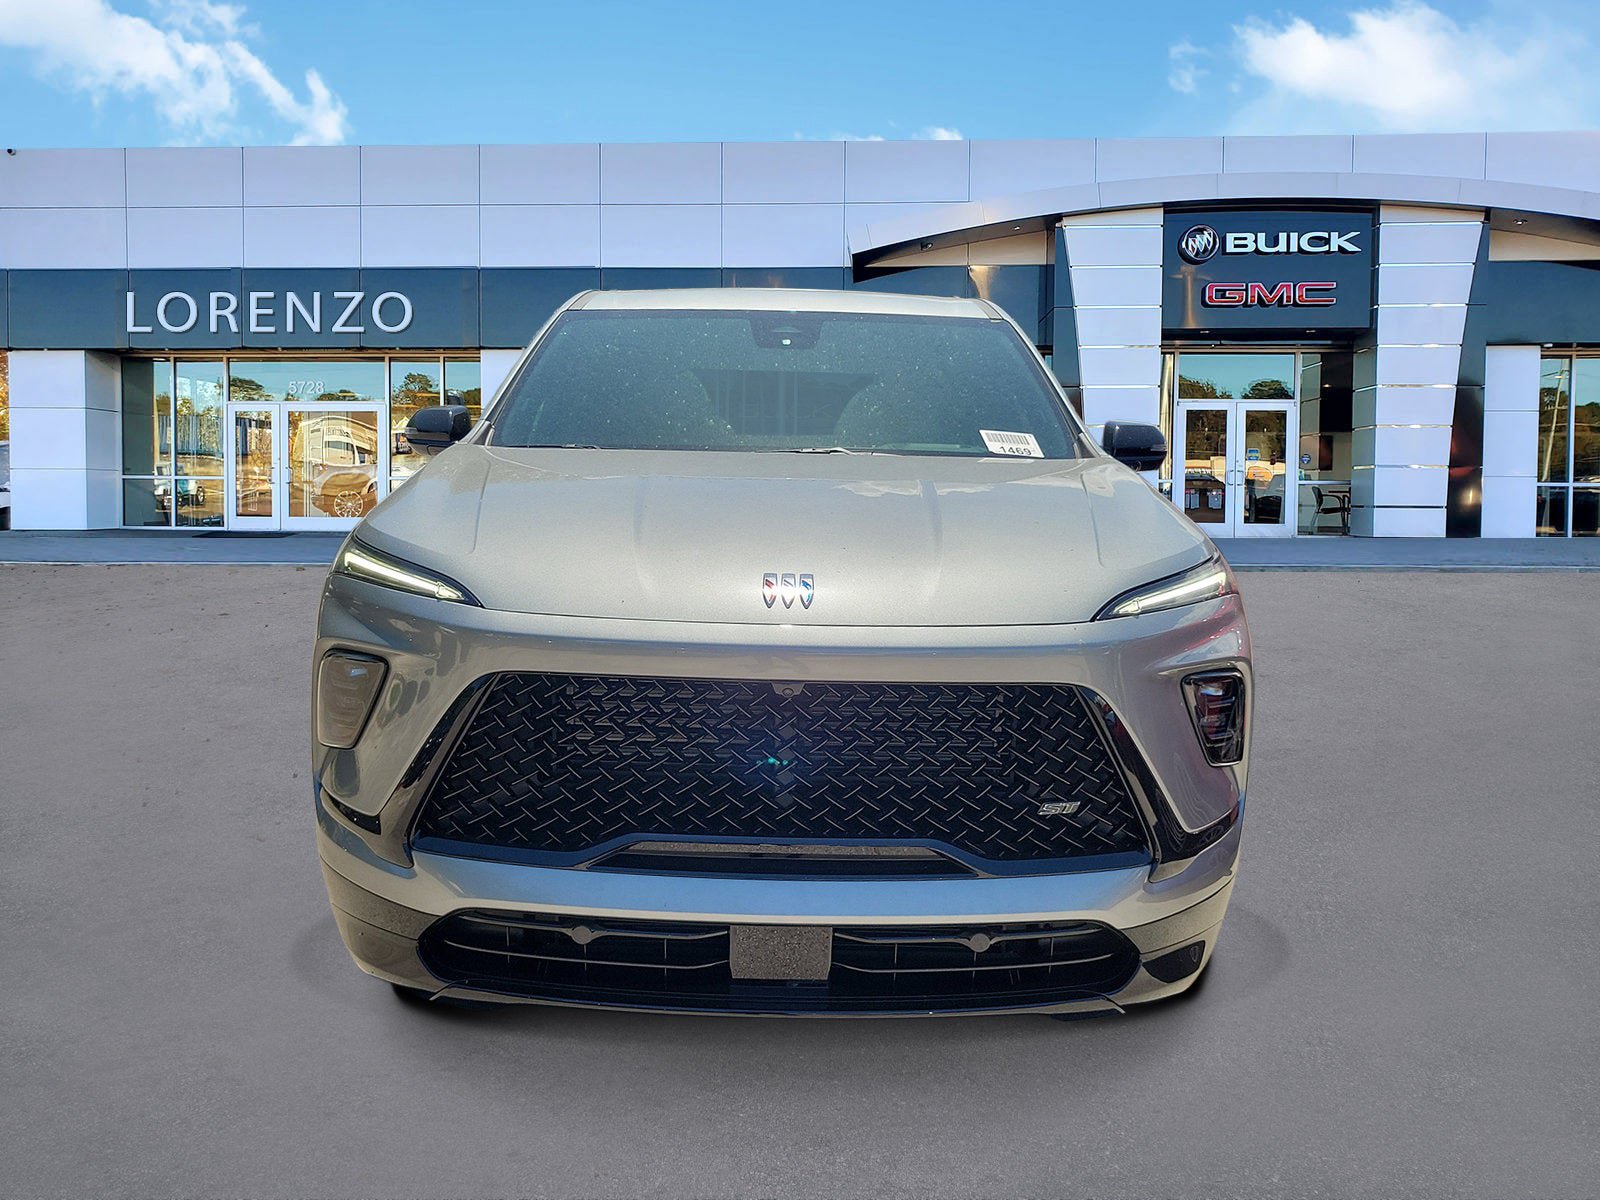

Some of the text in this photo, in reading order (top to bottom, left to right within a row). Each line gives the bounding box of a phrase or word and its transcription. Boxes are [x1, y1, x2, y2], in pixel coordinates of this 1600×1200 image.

[1225, 231, 1362, 253] BUICK
[1206, 282, 1336, 305] GMC
[126, 291, 414, 334] LORENZO
[288, 380, 325, 394] 5728
